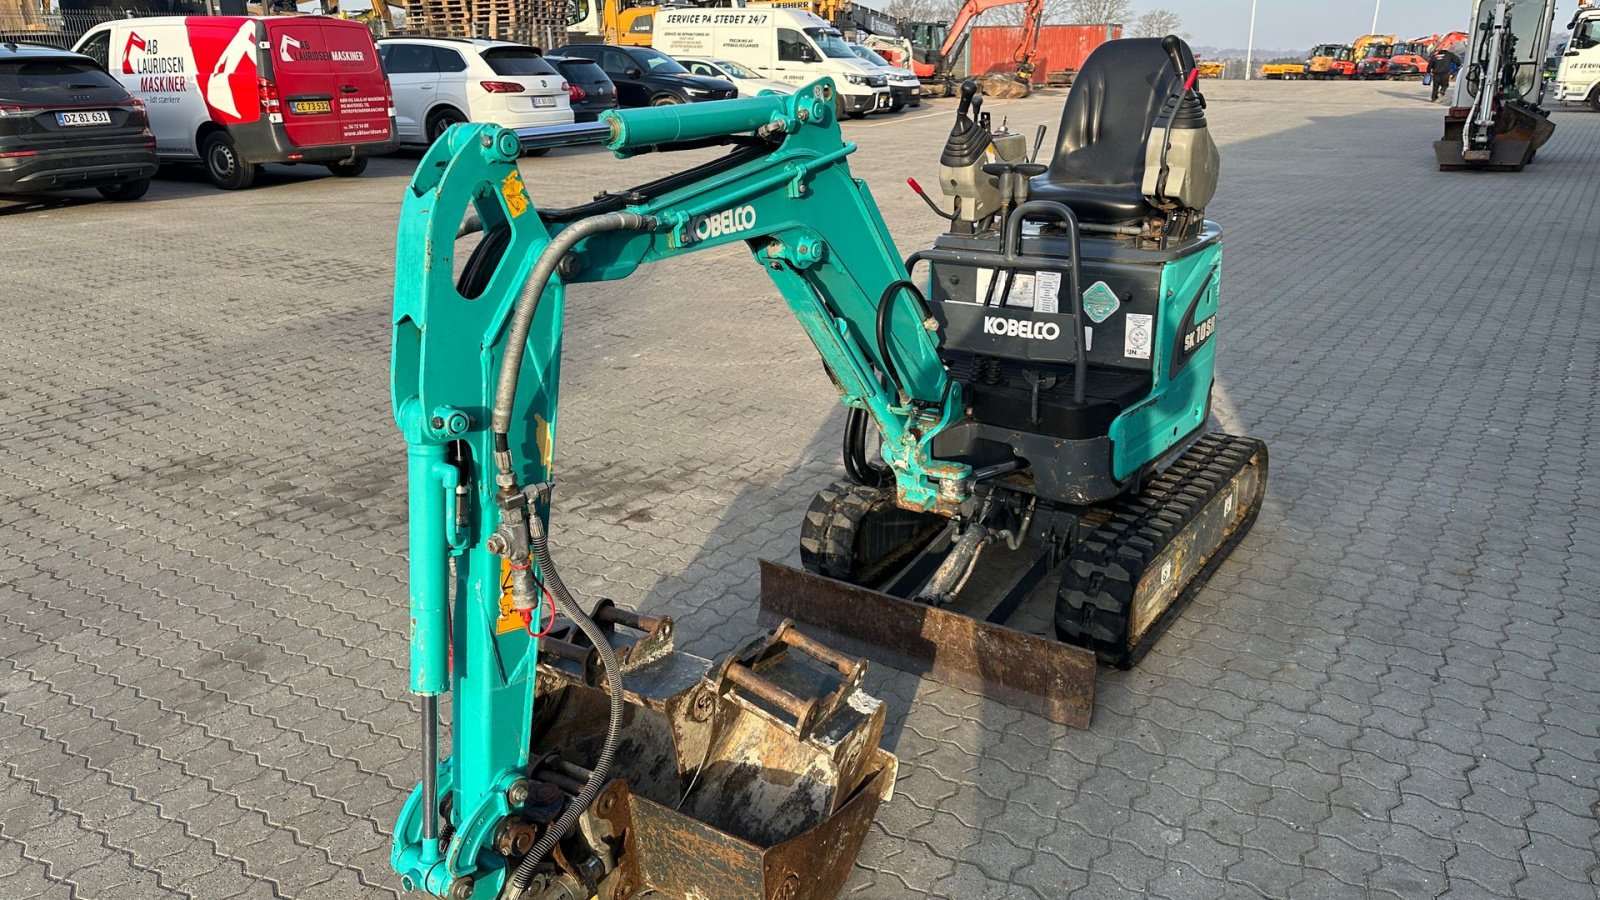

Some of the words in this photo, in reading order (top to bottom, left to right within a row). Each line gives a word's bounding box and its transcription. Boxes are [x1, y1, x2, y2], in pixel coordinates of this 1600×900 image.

[667, 15, 700, 23] SERVICE
[714, 15, 745, 23] STEDET
[748, 15, 767, 24] 24/7
[147, 40, 158, 54] AB
[300, 41, 310, 49] AB
[294, 51, 332, 61] LAURIDSEN
[332, 51, 364, 61] MASKINER
[137, 57, 184, 74] LAURIDSEN
[141, 76, 186, 92] MASKINER
[296, 102, 306, 110] CE
[307, 102, 316, 110] 73
[318, 102, 330, 110] 532
[64, 114, 77, 123] DZ
[80, 113, 89, 122] 81
[92, 112, 108, 122] 631
[686, 205, 756, 243] KOBELCO
[983, 316, 1060, 340] KOBELCO
[1184, 330, 1196, 351] SK
